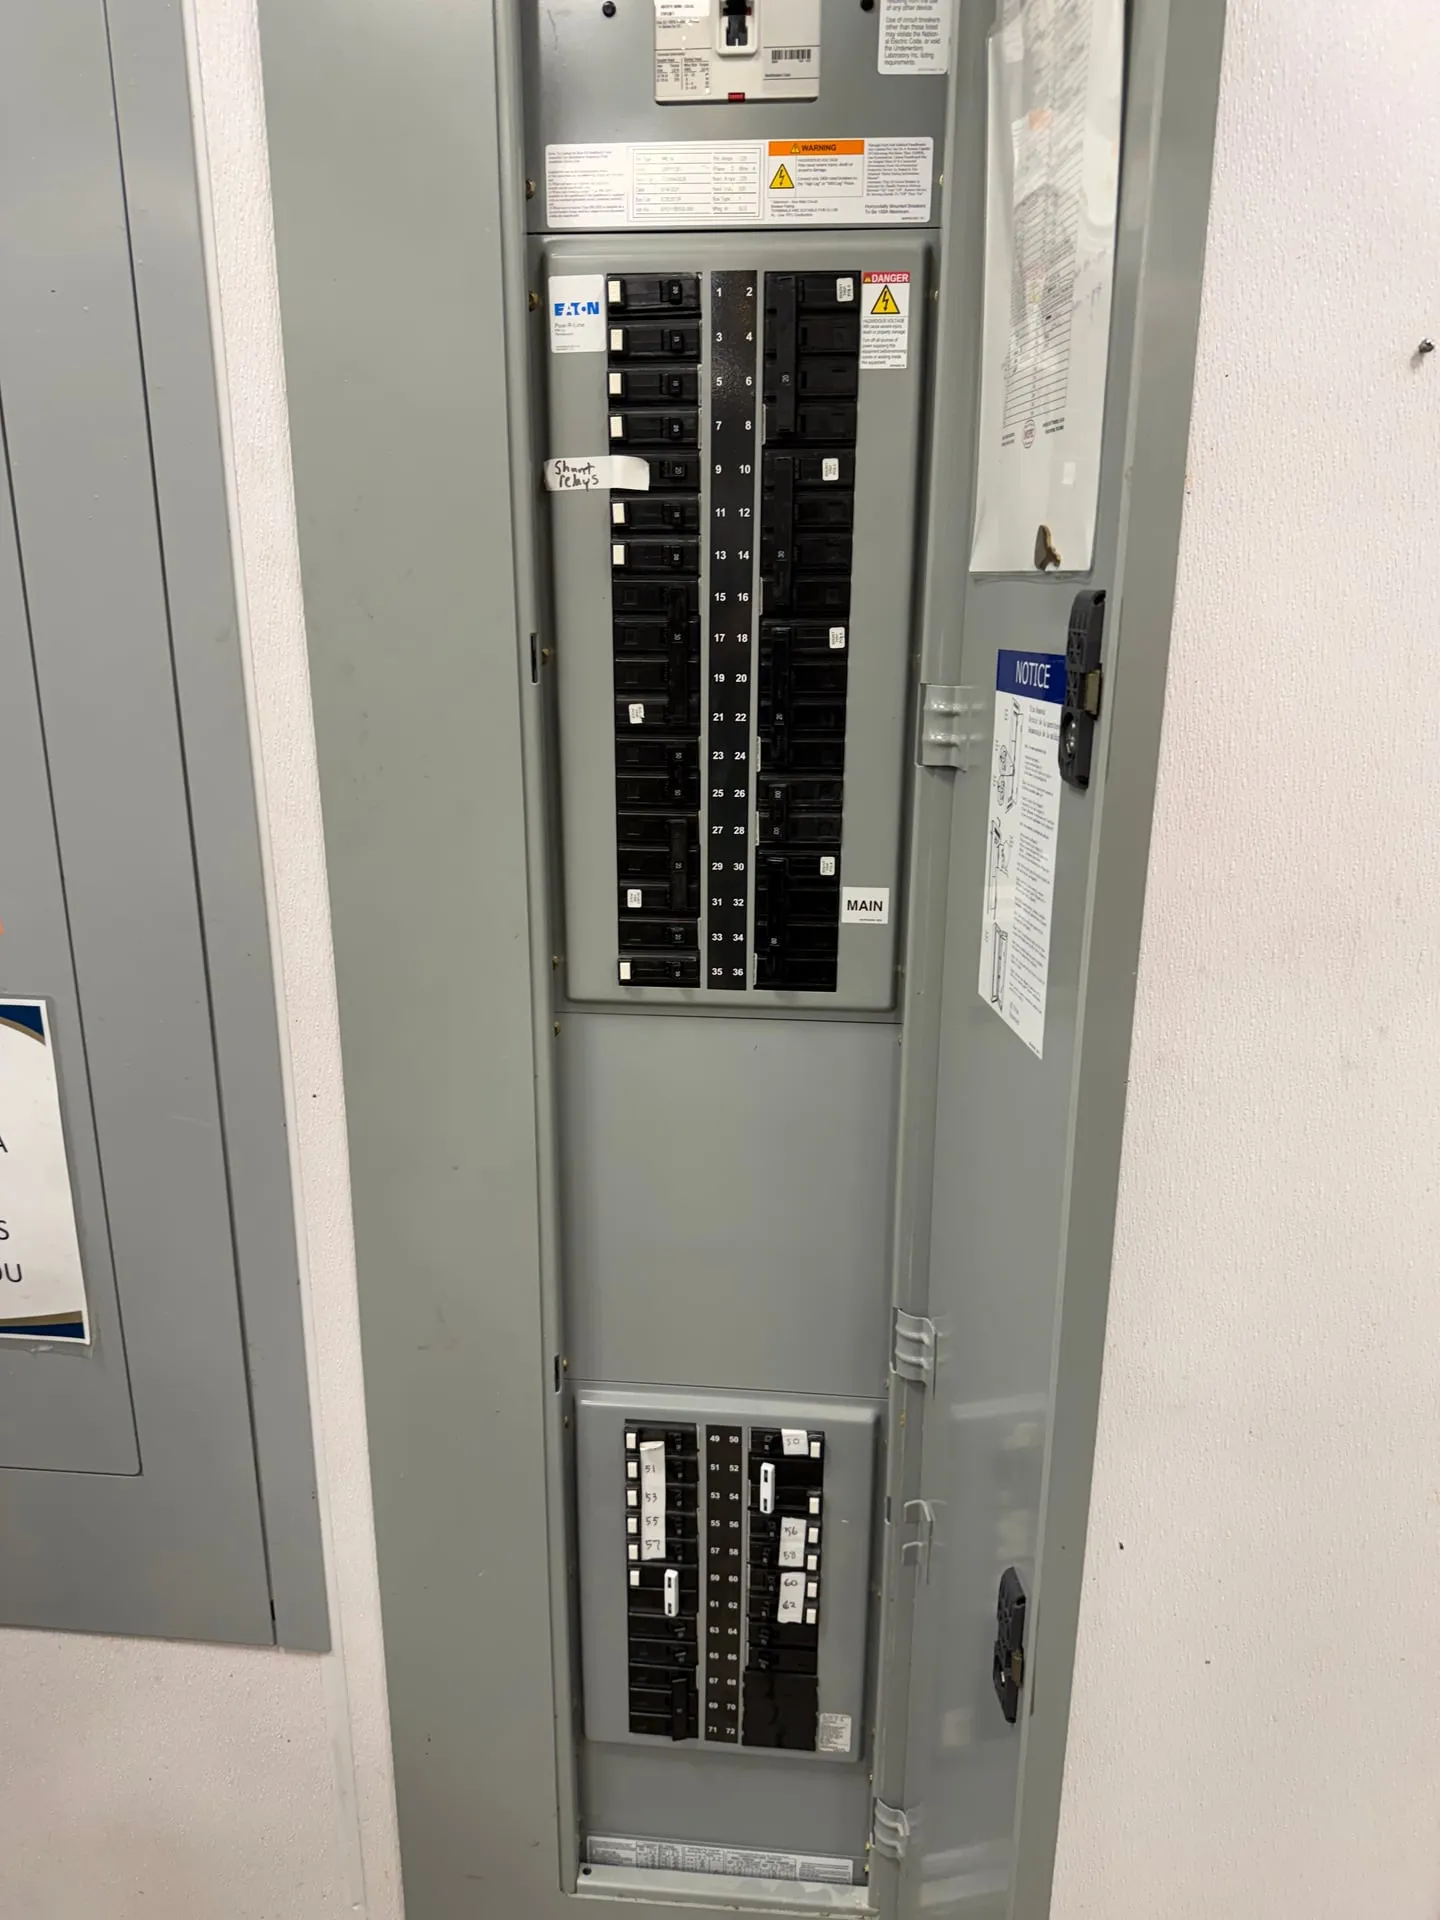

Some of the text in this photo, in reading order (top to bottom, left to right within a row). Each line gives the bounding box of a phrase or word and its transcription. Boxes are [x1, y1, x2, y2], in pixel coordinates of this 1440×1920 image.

[801, 144, 837, 153] WARNING
[871, 273, 909, 283] DANGER
[716, 286, 753, 297] 1 2
[715, 331, 753, 342] 3 4
[716, 376, 753, 387] 5 6
[715, 420, 752, 431] 7 8
[554, 460, 596, 475] Shunt
[715, 464, 751, 475] 9 10
[559, 474, 600, 492] relays
[715, 507, 751, 518] 11 12
[714, 550, 750, 560] 13 14
[714, 592, 749, 602] 15 16
[713, 633, 748, 643] 17 18
[713, 673, 748, 683] 19 20
[1015, 660, 1052, 689] NOTICE
[712, 712, 747, 722] 21 22
[712, 751, 746, 760] 23 24
[712, 788, 746, 798] 25 26
[711, 825, 745, 835] 27 28
[711, 862, 745, 871] 29 30
[711, 897, 745, 907] 31 32
[847, 899, 884, 912] MAIN
[711, 932, 744, 942] 33 34
[711, 967, 744, 977] 35 36
[709, 1434, 740, 1444] 49 50
[645, 1464, 656, 1473] 51
[645, 1493, 658, 1503] 53
[710, 1491, 721, 1500] 53
[645, 1516, 660, 1526] 55
[645, 1539, 661, 1551] 57
[710, 1546, 721, 1555] 57
[710, 1573, 721, 1582] 59
[784, 1579, 799, 1588] 60
[782, 1602, 797, 1611] 62
[708, 1651, 720, 1660] 65
